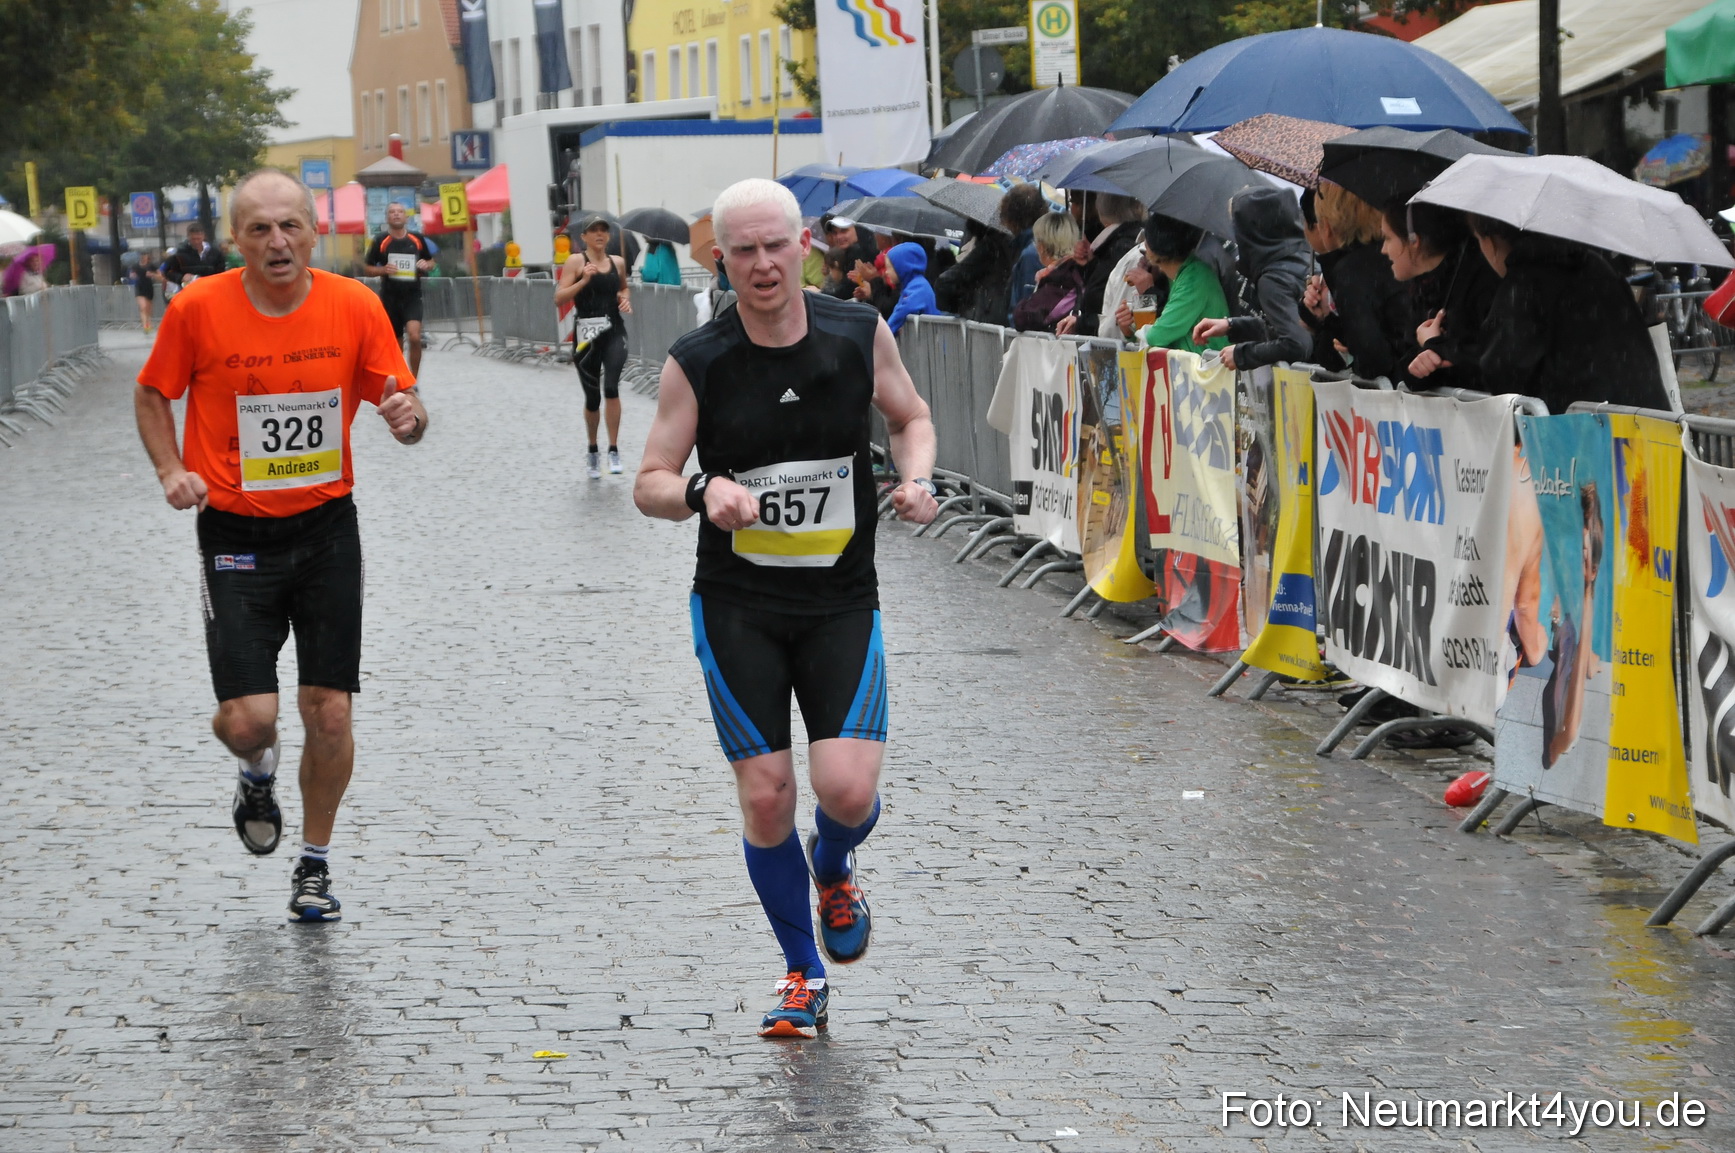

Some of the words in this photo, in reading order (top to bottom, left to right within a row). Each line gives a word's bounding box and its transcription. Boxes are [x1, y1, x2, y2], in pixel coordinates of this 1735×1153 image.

[673, 9, 696, 35] HOTEL
[68, 188, 91, 197] Block
[442, 185, 465, 193] Block
[74, 200, 88, 219] D
[448, 196, 462, 216] D
[134, 216, 151, 225] TAXI
[283, 353, 303, 364] DER
[304, 351, 326, 360] NEUE
[327, 348, 341, 358] TAG
[240, 404, 275, 414] PARTL
[277, 401, 325, 412] Neumarkt
[261, 415, 323, 453] 328
[267, 460, 320, 476] Andreas
[740, 477, 776, 488] PARTL
[779, 471, 833, 485] Neumarkt
[759, 487, 831, 527] 657
[1442, 637, 1481, 670] 92318
